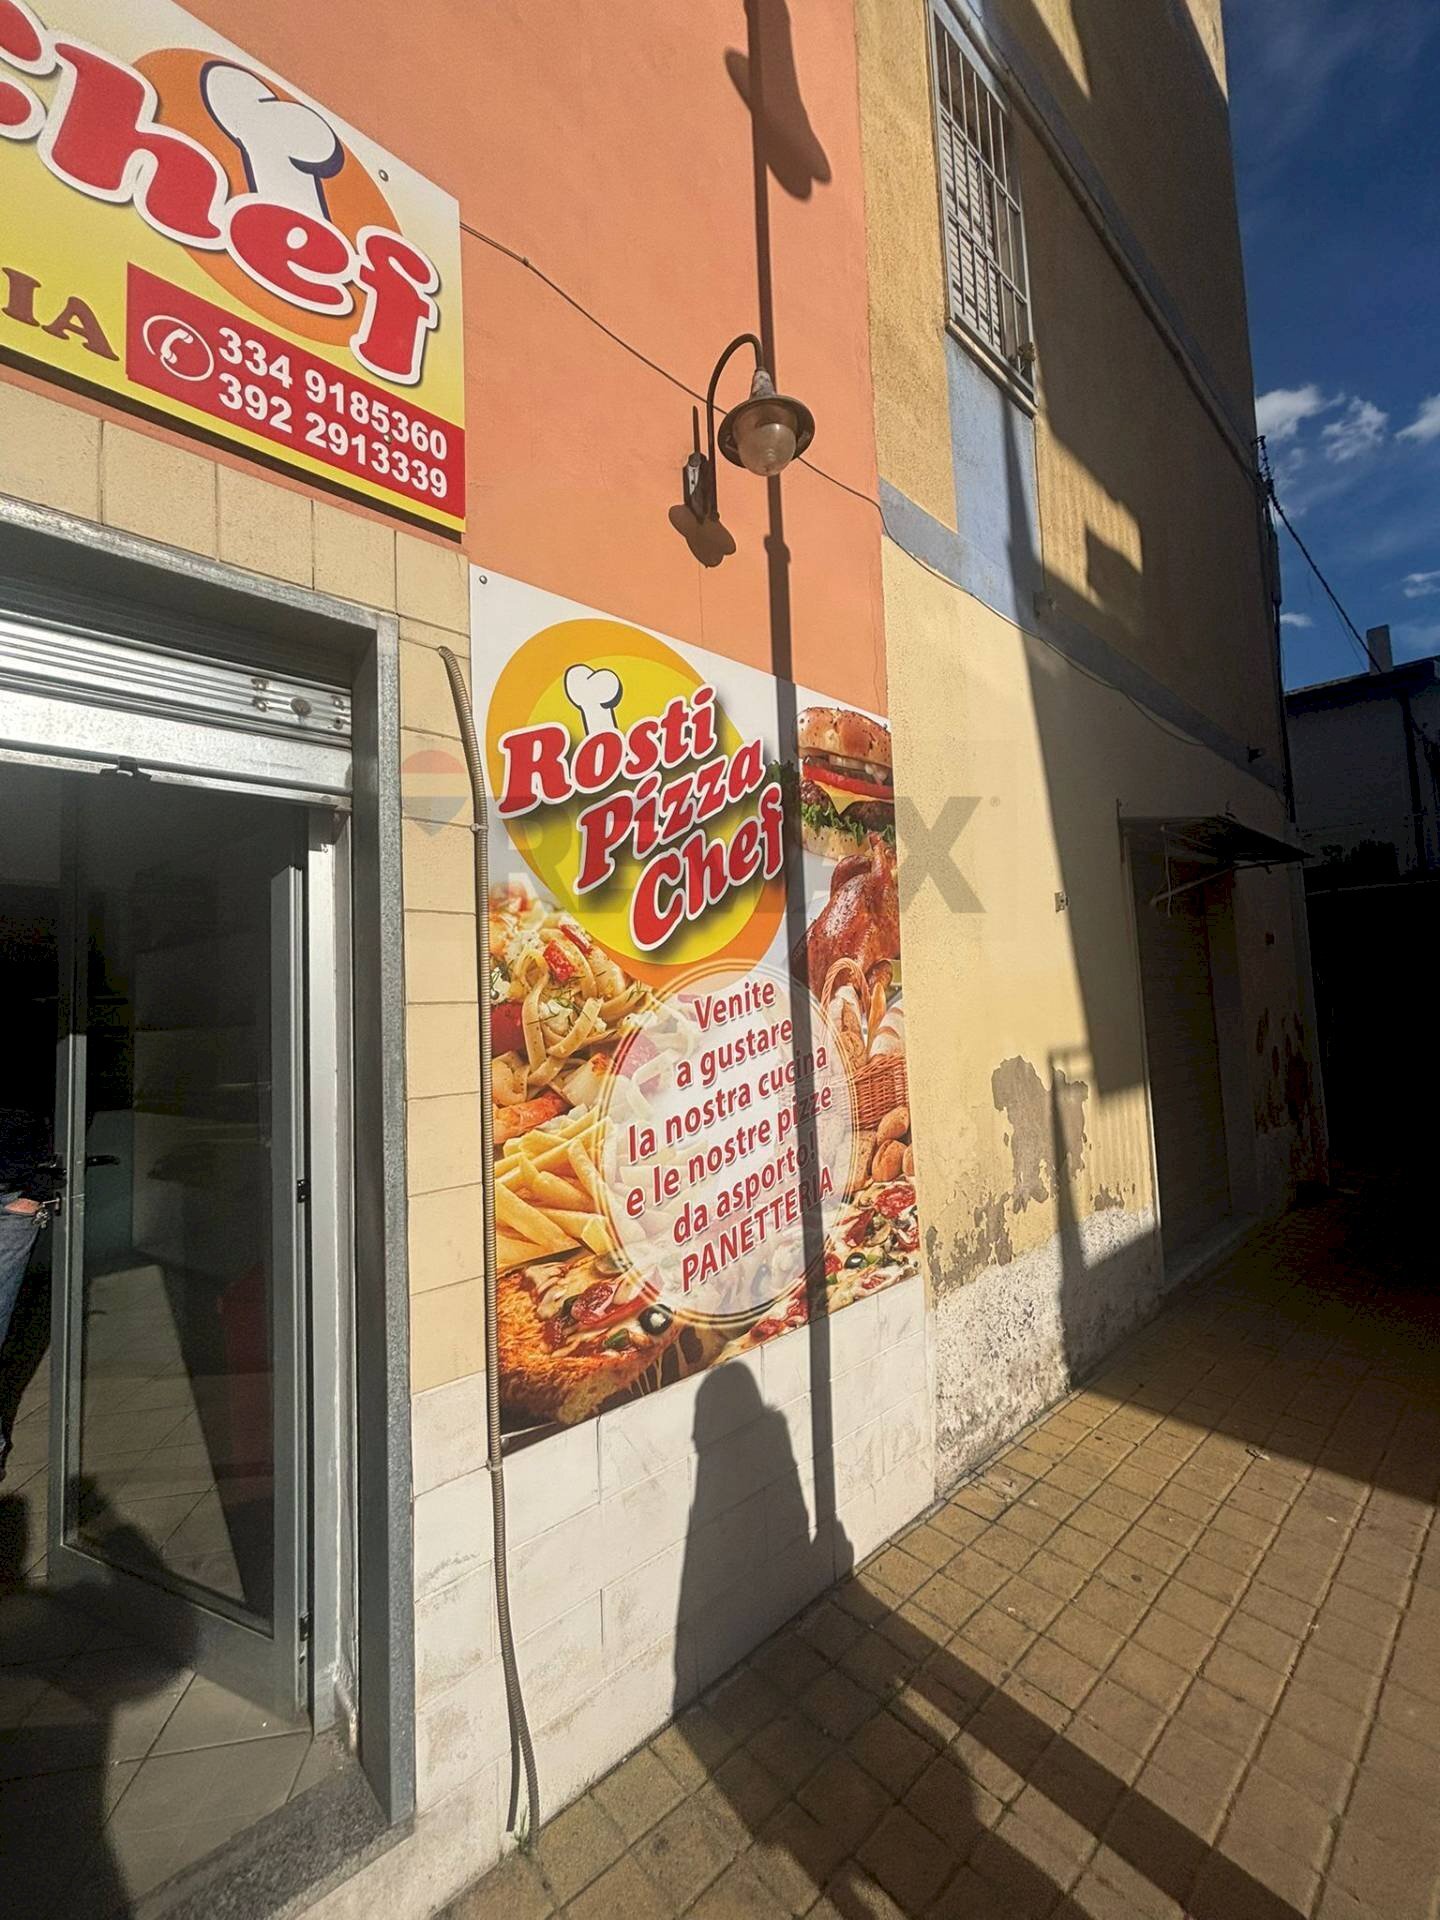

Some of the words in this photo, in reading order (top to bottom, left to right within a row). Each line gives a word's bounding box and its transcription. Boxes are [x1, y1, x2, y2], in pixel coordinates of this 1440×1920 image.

[218, 327, 293, 389] 334
[304, 368, 448, 460] 9185360
[218, 372, 293, 434] 392
[304, 411, 448, 498] 2913339
[498, 685, 716, 818] Rosti
[575, 738, 766, 893] Pizza
[629, 783, 783, 950] Chef
[676, 1059, 693, 1089] a
[699, 1019, 794, 1087] gustare
[693, 980, 776, 1032] Venite
[625, 1185, 646, 1219] e
[653, 1165, 681, 1207] le
[688, 1117, 772, 1184] nostre
[776, 1085, 833, 1144] pizze
[628, 1124, 656, 1164] la
[664, 1081, 752, 1147] nostra
[757, 1045, 829, 1099] cucina
[672, 1201, 709, 1246] da
[680, 1165, 834, 1293] PANETTERIA
